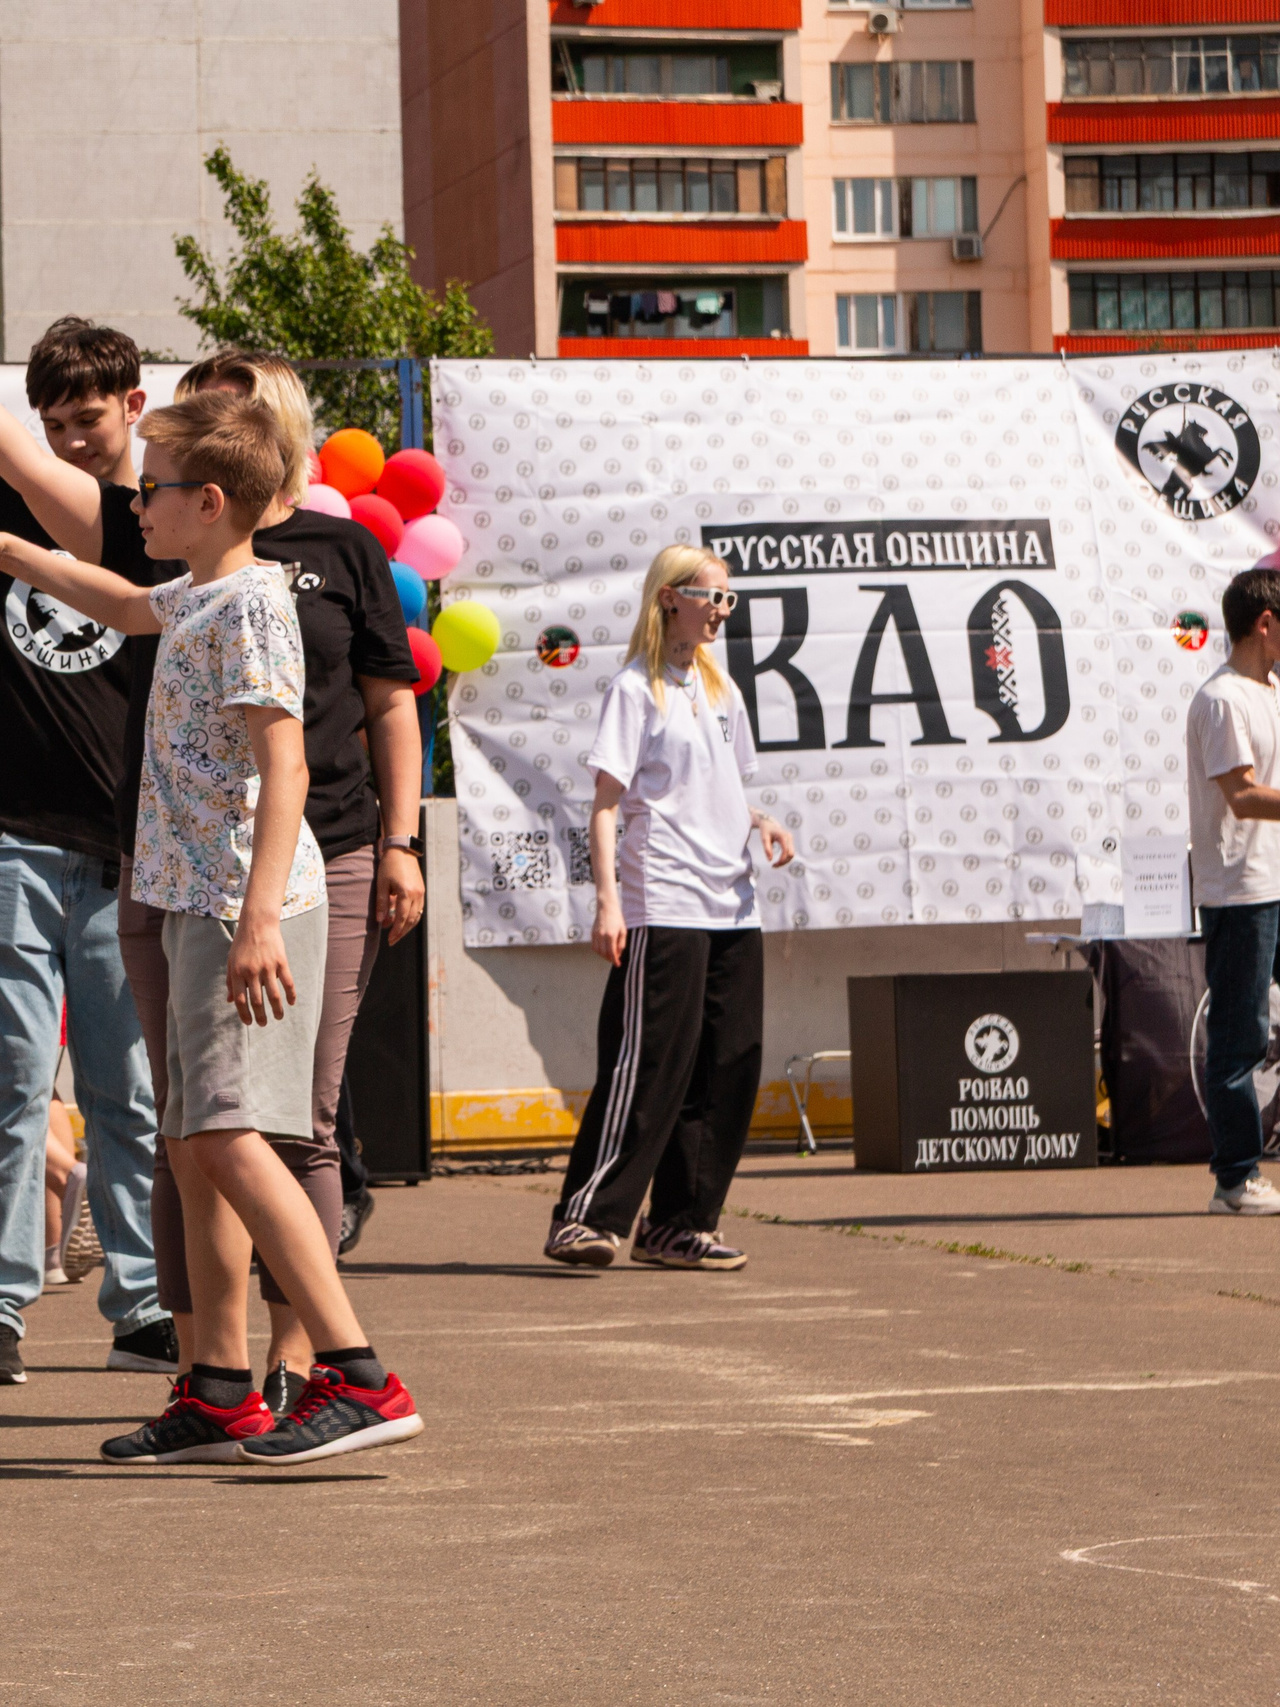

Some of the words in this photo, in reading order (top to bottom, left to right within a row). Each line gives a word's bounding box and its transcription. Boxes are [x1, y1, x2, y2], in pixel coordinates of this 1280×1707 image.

[1121, 384, 1249, 434] РУССКАЯ
[710, 531, 878, 571] РУССКАЯ
[885, 530, 1048, 570] ОБЩИНА
[12, 622, 109, 670] ОБЩИНА
[723, 579, 1071, 752] ВАО
[950, 1105, 1040, 1133] ПОМОЩЬ
[915, 1136, 1020, 1169] ДЕТСКОМУ
[1024, 1133, 1081, 1165] ДОМУ
